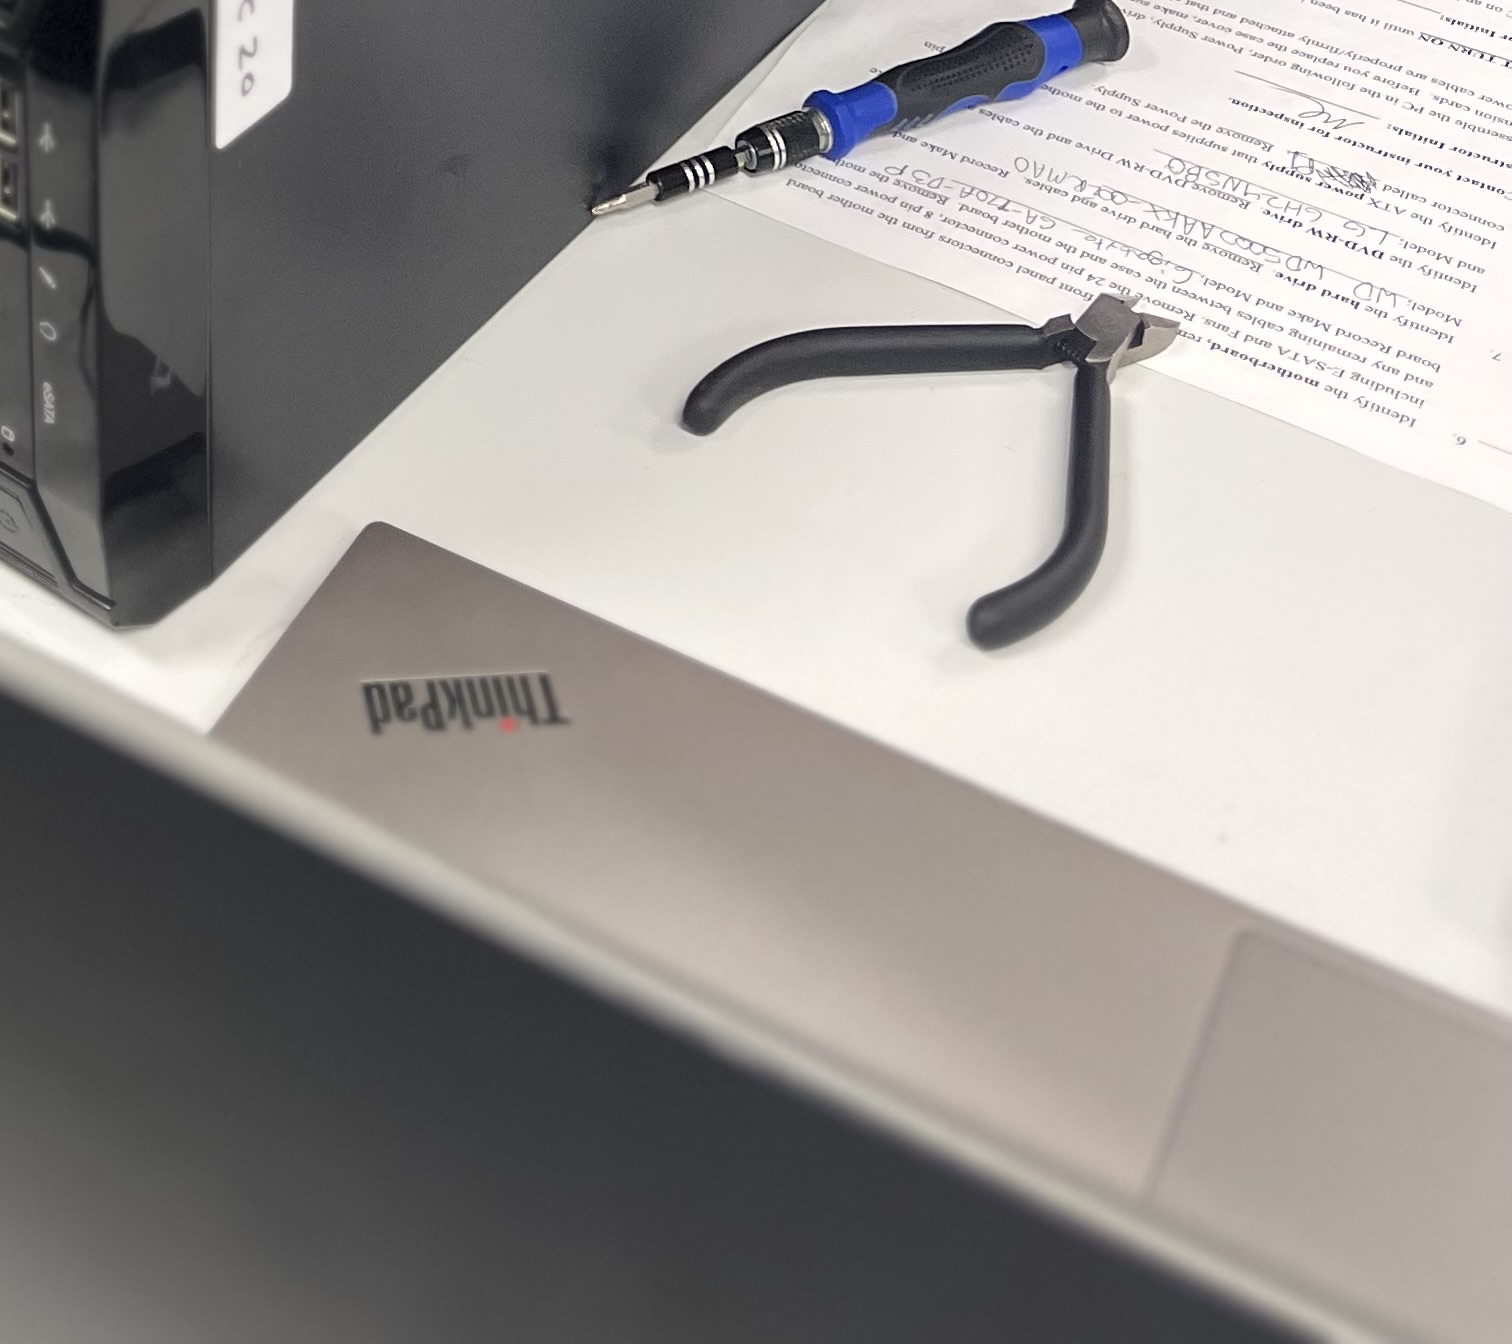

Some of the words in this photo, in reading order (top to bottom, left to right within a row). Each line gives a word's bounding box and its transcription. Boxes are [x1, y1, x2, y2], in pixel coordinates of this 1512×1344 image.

[1151, 3, 1189, 20] make
[1210, 8, 1238, 20] and
[1342, 9, 1367, 22] has
[1238, 16, 1296, 38] attached
[1382, 22, 1415, 36] until
[1438, 14, 1496, 38] Initials:
[1200, 34, 1244, 54] Power
[1234, 30, 1264, 43] case
[1265, 40, 1288, 52] the
[922, 40, 948, 54] pin
[1296, 34, 1404, 72] properly/firmly
[1446, 42, 1496, 63] TURN
[237, 36, 258, 98] 20
[1288, 47, 1340, 68] replace
[1288, 62, 1356, 90] following
[1342, 64, 1370, 78] you
[1404, 69, 1428, 80] are
[1358, 86, 1382, 99] the
[1370, 74, 1420, 96] Before
[1428, 78, 1475, 97] cables
[1083, 99, 1107, 112] the
[1107, 107, 1124, 118] to
[1142, 102, 1188, 122] Power
[1427, 109, 1451, 122] the
[976, 108, 1020, 128] cables
[1124, 112, 1170, 132] power
[1188, 118, 1212, 131] the
[890, 130, 918, 144] and
[1020, 123, 1044, 137] the
[1044, 132, 1073, 146] and
[1214, 126, 1274, 152] Remove
[1306, 124, 1330, 138] for
[1386, 124, 1445, 150] Initials:
[918, 140, 959, 160] Make
[1169, 128, 1229, 153] supplies
[1332, 134, 1411, 165] instructor
[1072, 141, 1114, 161] Drive
[1229, 149, 1258, 164] that
[958, 154, 1010, 178] Record
[1114, 157, 1189, 188] DVD-RW
[1260, 159, 1313, 184] supply
[1413, 160, 1453, 177] your
[866, 169, 890, 184] the
[784, 177, 826, 198] board
[852, 182, 900, 204] power
[890, 178, 950, 206] Remove
[1189, 182, 1250, 210] Remove
[1314, 176, 1365, 200] power
[1381, 184, 1427, 204] called
[824, 192, 876, 216] mother
[896, 199, 924, 214] pin
[1068, 194, 1098, 210] and
[1366, 196, 1406, 216] ATX
[874, 211, 900, 226] the
[922, 209, 934, 220] 8
[1098, 206, 1138, 225] drive
[1408, 212, 1433, 226] the
[1428, 200, 1506, 232] connector
[898, 220, 936, 240] from
[999, 219, 1053, 244] mother
[1138, 220, 1173, 239] hard
[1343, 222, 1388, 244] LG
[1436, 220, 1498, 249] Identify
[1052, 240, 1078, 254] the
[1173, 234, 1198, 248] the
[1304, 226, 1385, 260] DVD-RW
[935, 234, 1014, 270] connectors
[1010, 241, 1060, 265] power
[1078, 250, 1108, 266] and
[1199, 243, 1263, 273] Remove
[1388, 254, 1413, 269] the
[1014, 264, 1058, 286] panel
[1058, 260, 1086, 277] pin
[1108, 261, 1142, 278] case
[1416, 262, 1478, 292] Identify
[1455, 259, 1486, 275] and
[1084, 272, 1106, 286] 24
[1106, 280, 1132, 296] the
[1142, 275, 1168, 290] the
[1056, 281, 1095, 302] front
[1169, 284, 1232, 316] between
[1319, 288, 1360, 310] hard
[1352, 281, 1394, 307] WD
[1130, 291, 1196, 322] Remove
[1254, 296, 1284, 313] and
[1362, 304, 1388, 320] the
[1234, 309, 1284, 334] cables
[1286, 308, 1332, 332] Make
[1391, 313, 1455, 344] Identify
[1242, 332, 1273, 350] and
[1286, 326, 1368, 365] remaining
[1334, 326, 1392, 354] Record
[1274, 344, 1345, 378] E-SATA
[1370, 358, 1402, 376] any
[1394, 348, 1441, 373] board
[1348, 370, 1426, 409] including
[1402, 372, 1434, 390] and
[1322, 384, 1349, 401] the
[42, 382, 56, 424] eSATA
[1352, 393, 1417, 428] Identify
[360, 673, 571, 736] ThinkPad
